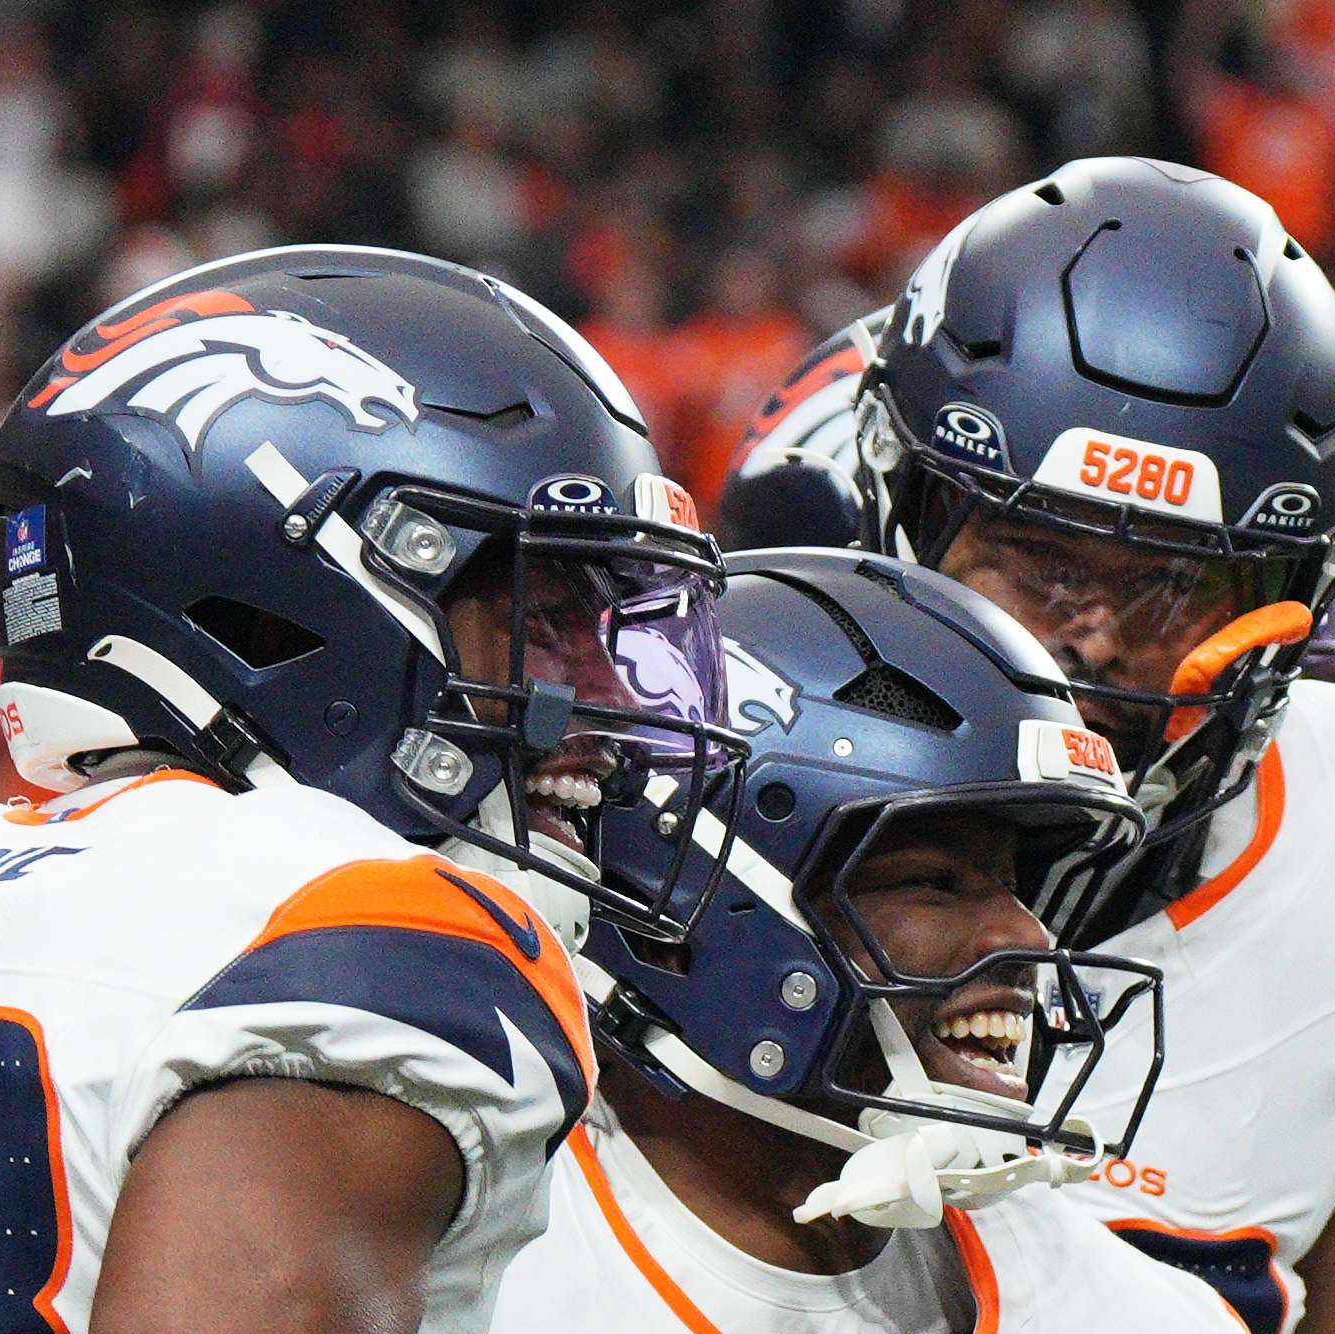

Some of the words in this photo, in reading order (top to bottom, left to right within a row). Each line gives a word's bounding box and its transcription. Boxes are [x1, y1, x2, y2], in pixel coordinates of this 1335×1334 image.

[936, 425, 998, 459] OAKLEY
[1080, 439, 1195, 506] 5280
[8, 548, 42, 572] CHANGE
